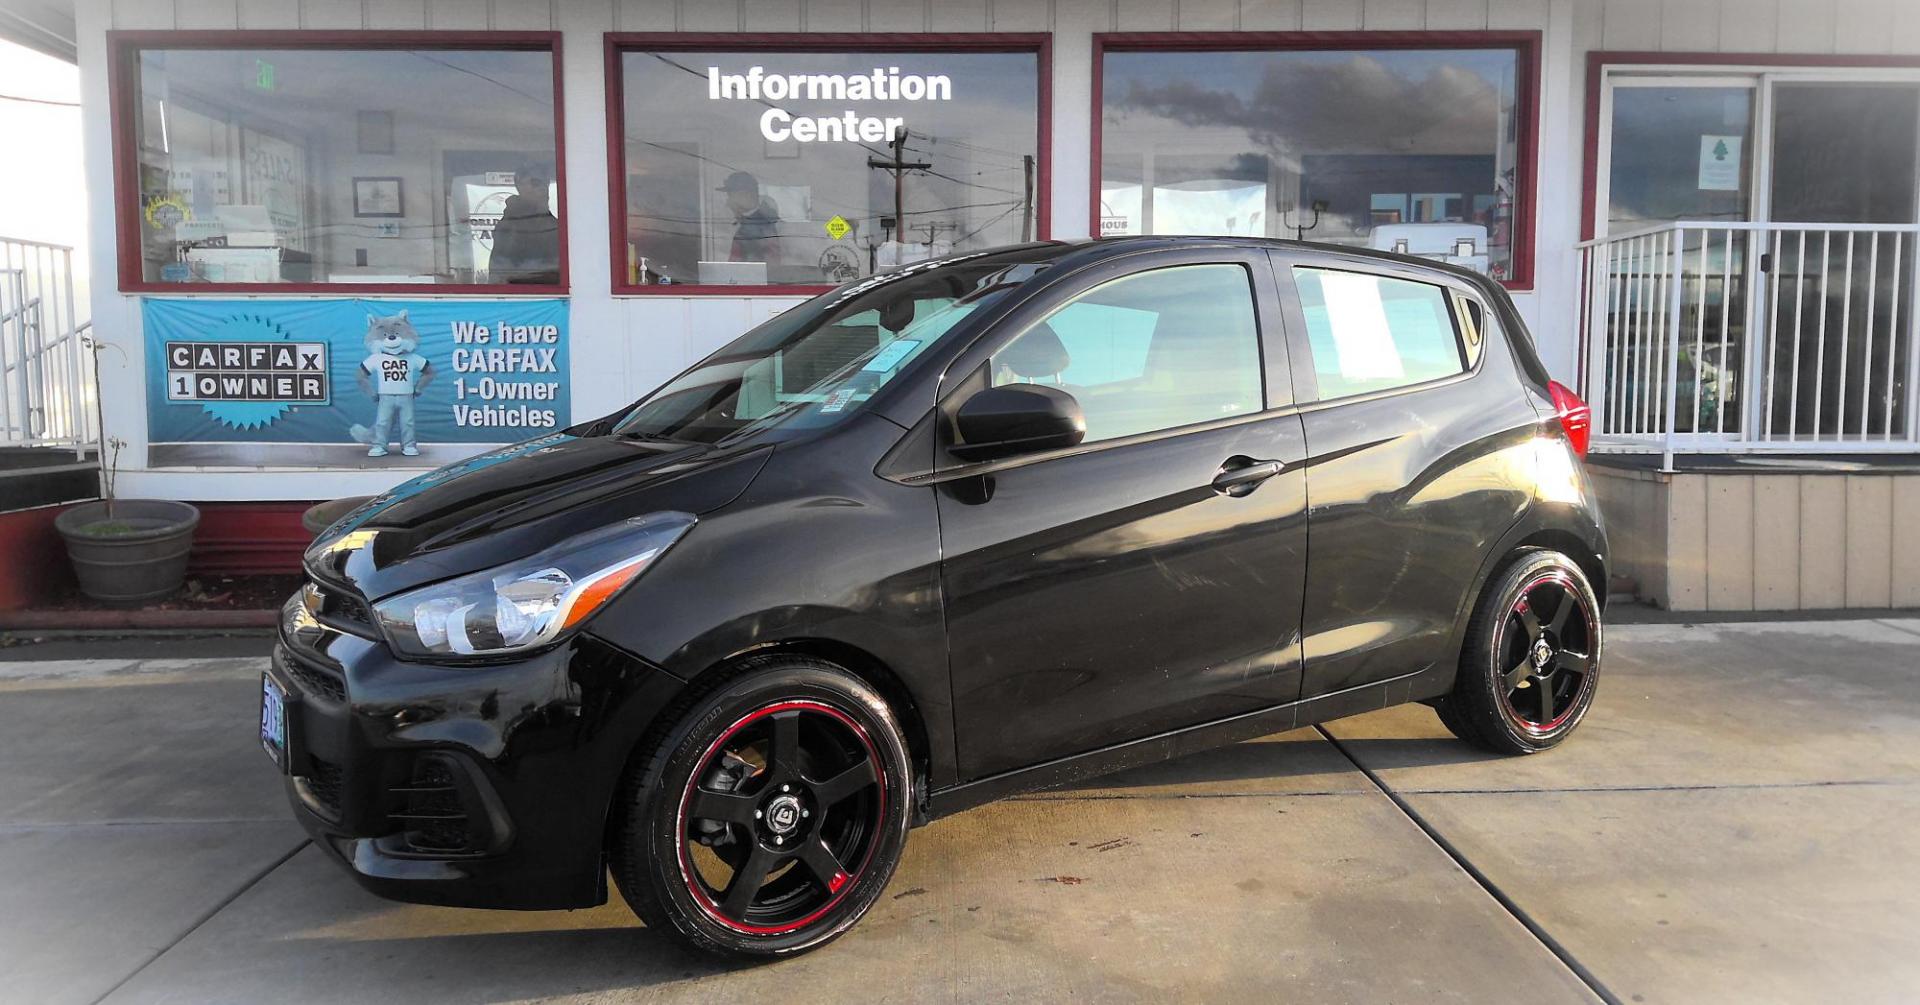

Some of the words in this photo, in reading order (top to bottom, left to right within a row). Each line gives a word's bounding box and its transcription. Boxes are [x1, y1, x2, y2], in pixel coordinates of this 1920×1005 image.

[708, 66, 952, 100] Information
[760, 108, 903, 142] Center
[450, 320, 490, 344] We
[497, 320, 559, 344] have
[172, 346, 320, 371] CARFAX
[381, 359, 409, 370] CAR
[452, 348, 557, 373] CARFAX
[383, 370, 408, 382] FOX
[453, 376, 559, 401] 1-Owner
[452, 404, 557, 428] Vehicles
